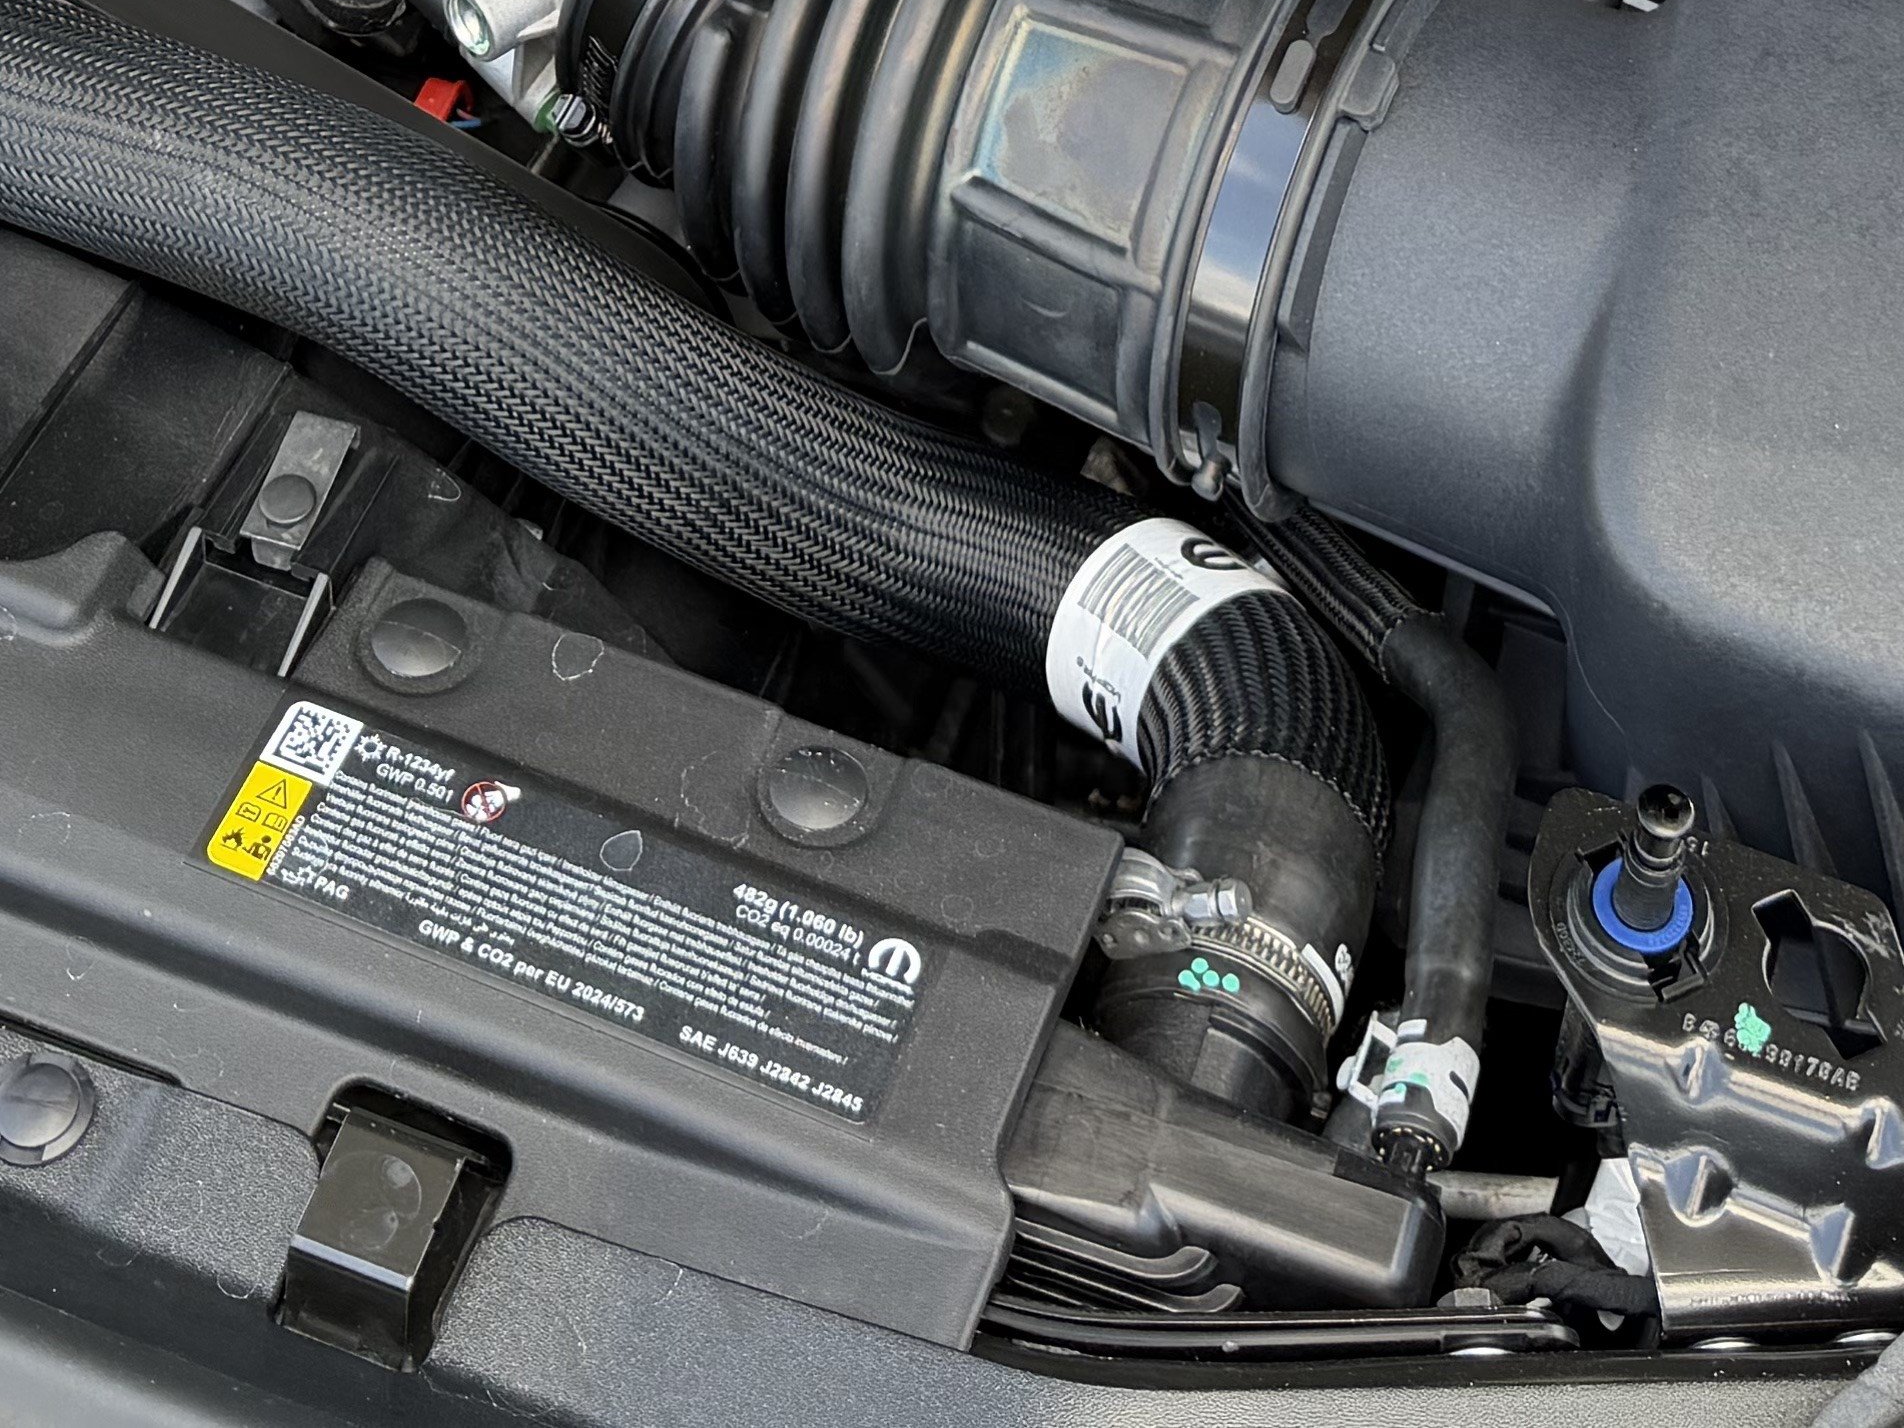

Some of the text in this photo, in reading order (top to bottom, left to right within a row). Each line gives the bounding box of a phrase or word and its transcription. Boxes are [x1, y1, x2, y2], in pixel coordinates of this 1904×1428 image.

[374, 761, 454, 803] GWP 0.501
[384, 744, 456, 785] R-1234yf
[313, 875, 350, 901] PAG
[730, 881, 780, 915] 482g
[778, 900, 837, 937] (1.060
[836, 923, 865, 949] lb)
[733, 903, 861, 966] CO2 eq 0.00024 t
[416, 918, 461, 947] GWP
[459, 935, 476, 953] &
[475, 942, 515, 968] CO2
[511, 959, 545, 984] per
[543, 969, 572, 991] EU
[570, 980, 646, 1022] 2024/573
[677, 1024, 864, 1113] SAE J639 J2842 J2845
